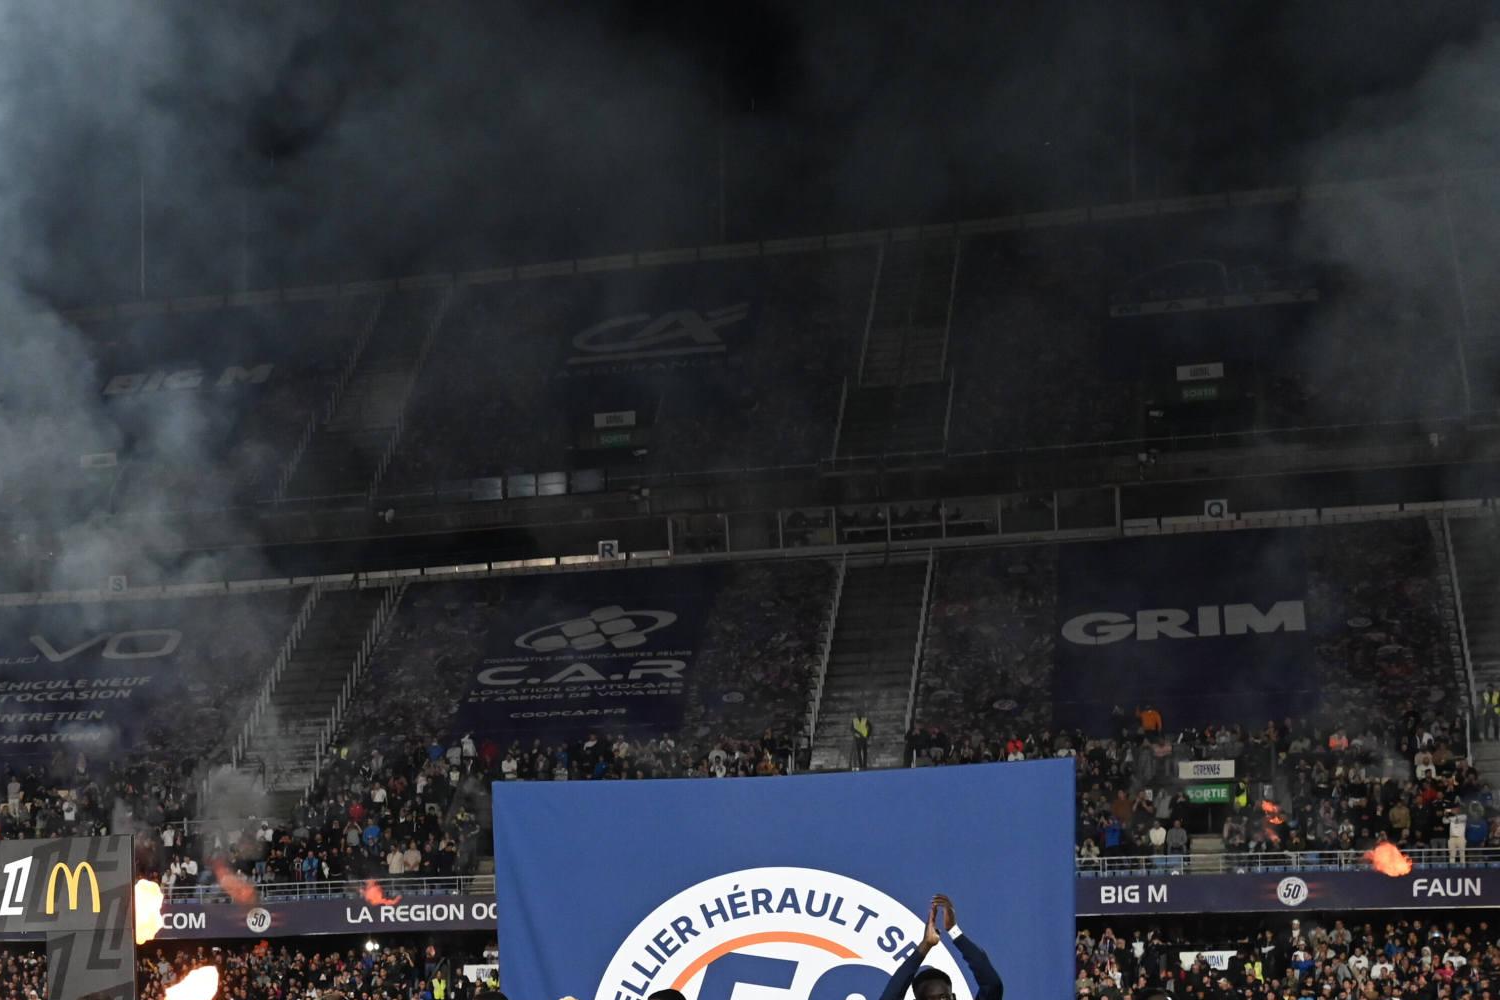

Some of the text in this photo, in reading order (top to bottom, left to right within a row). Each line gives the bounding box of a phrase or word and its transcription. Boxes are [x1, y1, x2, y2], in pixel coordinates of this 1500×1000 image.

[1207, 502, 1224, 518] Q
[602, 543, 614, 558] R
[111, 578, 123, 591] S
[1061, 600, 1306, 645] GRIM
[476, 659, 687, 685] C.A.R
[92, 675, 153, 687] NEUF
[16, 688, 132, 702] OCCASION
[470, 685, 561, 696] LOCATION
[494, 693, 564, 702] AGENCE
[597, 688, 682, 697] VOYAGES
[509, 707, 627, 719] COOPCAR.FR
[1100, 884, 1167, 904] BIG M
[1413, 878, 1481, 897] FAUN
[347, 907, 373, 923] LA
[381, 904, 465, 922] REGION
[699, 885, 879, 934] HÉRAULT
